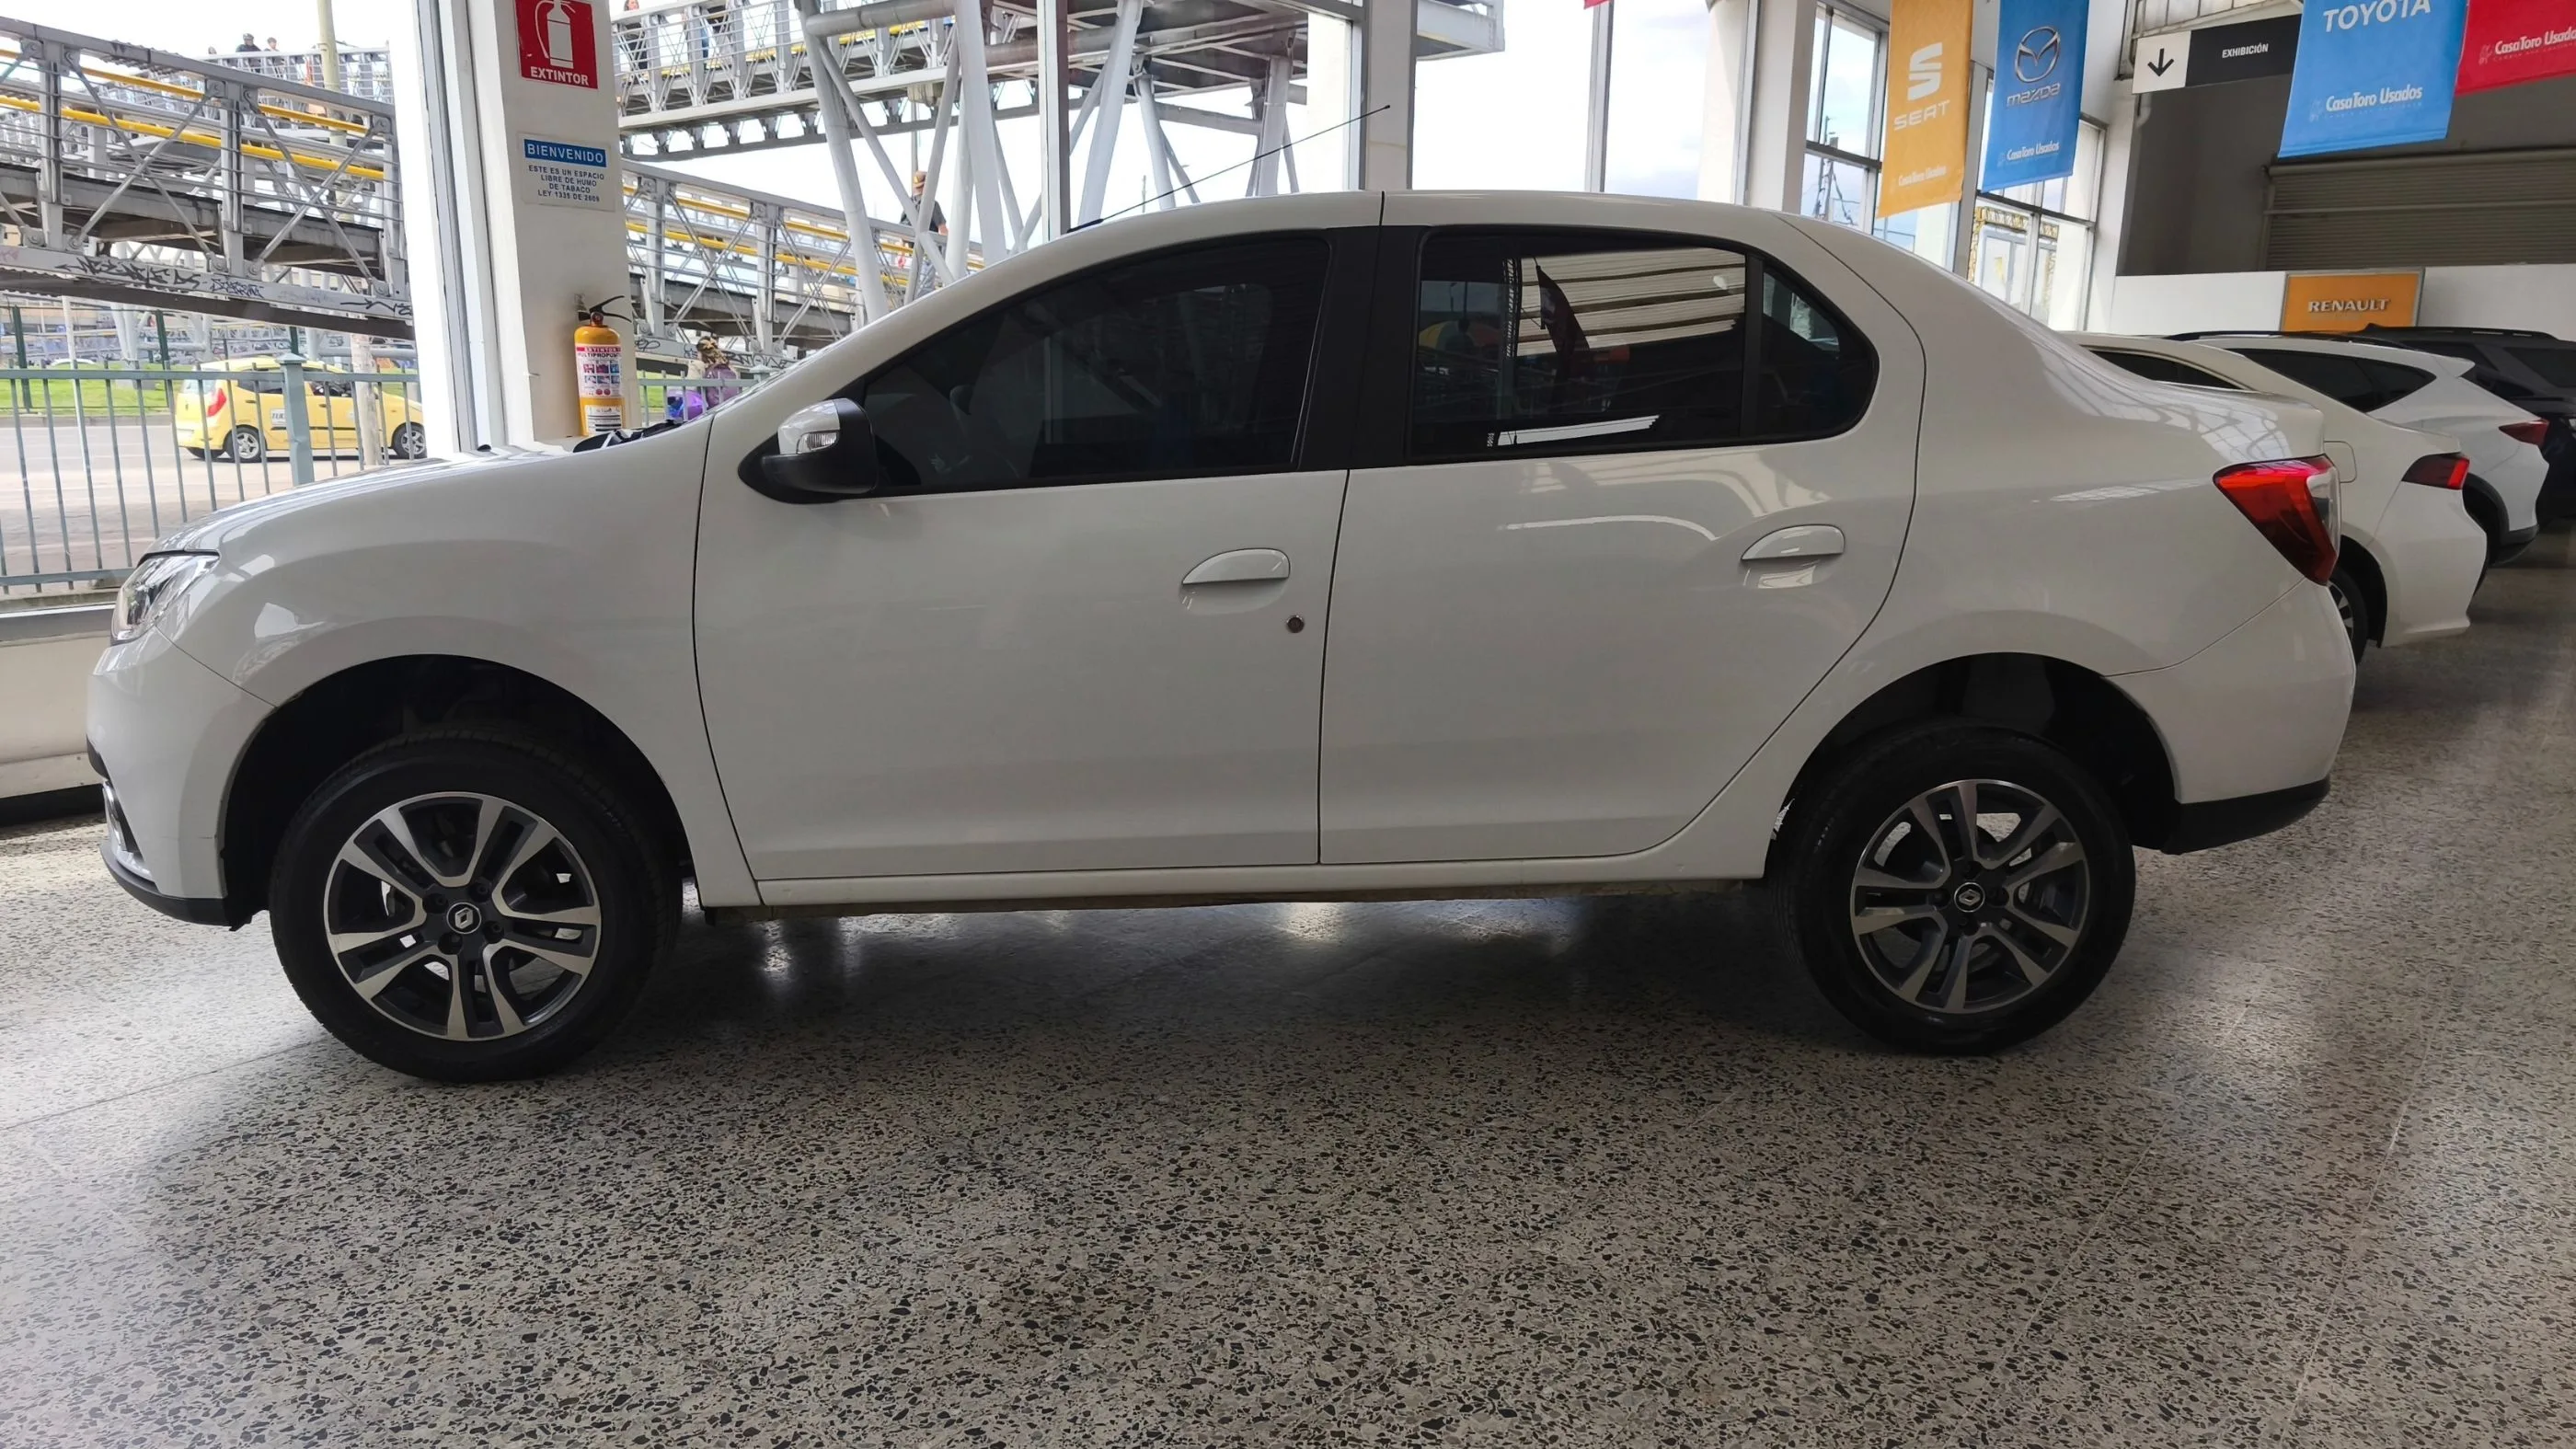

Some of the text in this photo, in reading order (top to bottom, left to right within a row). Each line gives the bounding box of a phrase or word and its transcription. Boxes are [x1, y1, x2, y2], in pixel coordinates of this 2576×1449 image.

[2323, 0, 2431, 32] TOYOTA
[2495, 36, 2542, 54] CasaToro
[2544, 26, 2576, 45] Usado
[2222, 42, 2269, 58] EXHIBICIÓN
[530, 65, 590, 86] EXTINTOR
[2326, 92, 2377, 111] CasaToro
[2379, 85, 2423, 104] Usados
[1893, 99, 1950, 131] SEAT
[527, 144, 604, 163] BIENVENIDO
[2035, 141, 2060, 155] Usados
[528, 165, 548, 174] ESTE
[561, 168, 572, 177] UN
[574, 170, 604, 180] ESPACIO
[540, 174, 563, 183] LIBRE
[577, 178, 597, 187] HUMO
[537, 190, 552, 198] LEY
[561, 184, 591, 194] TABACO
[2308, 299, 2389, 313] RENAULT
